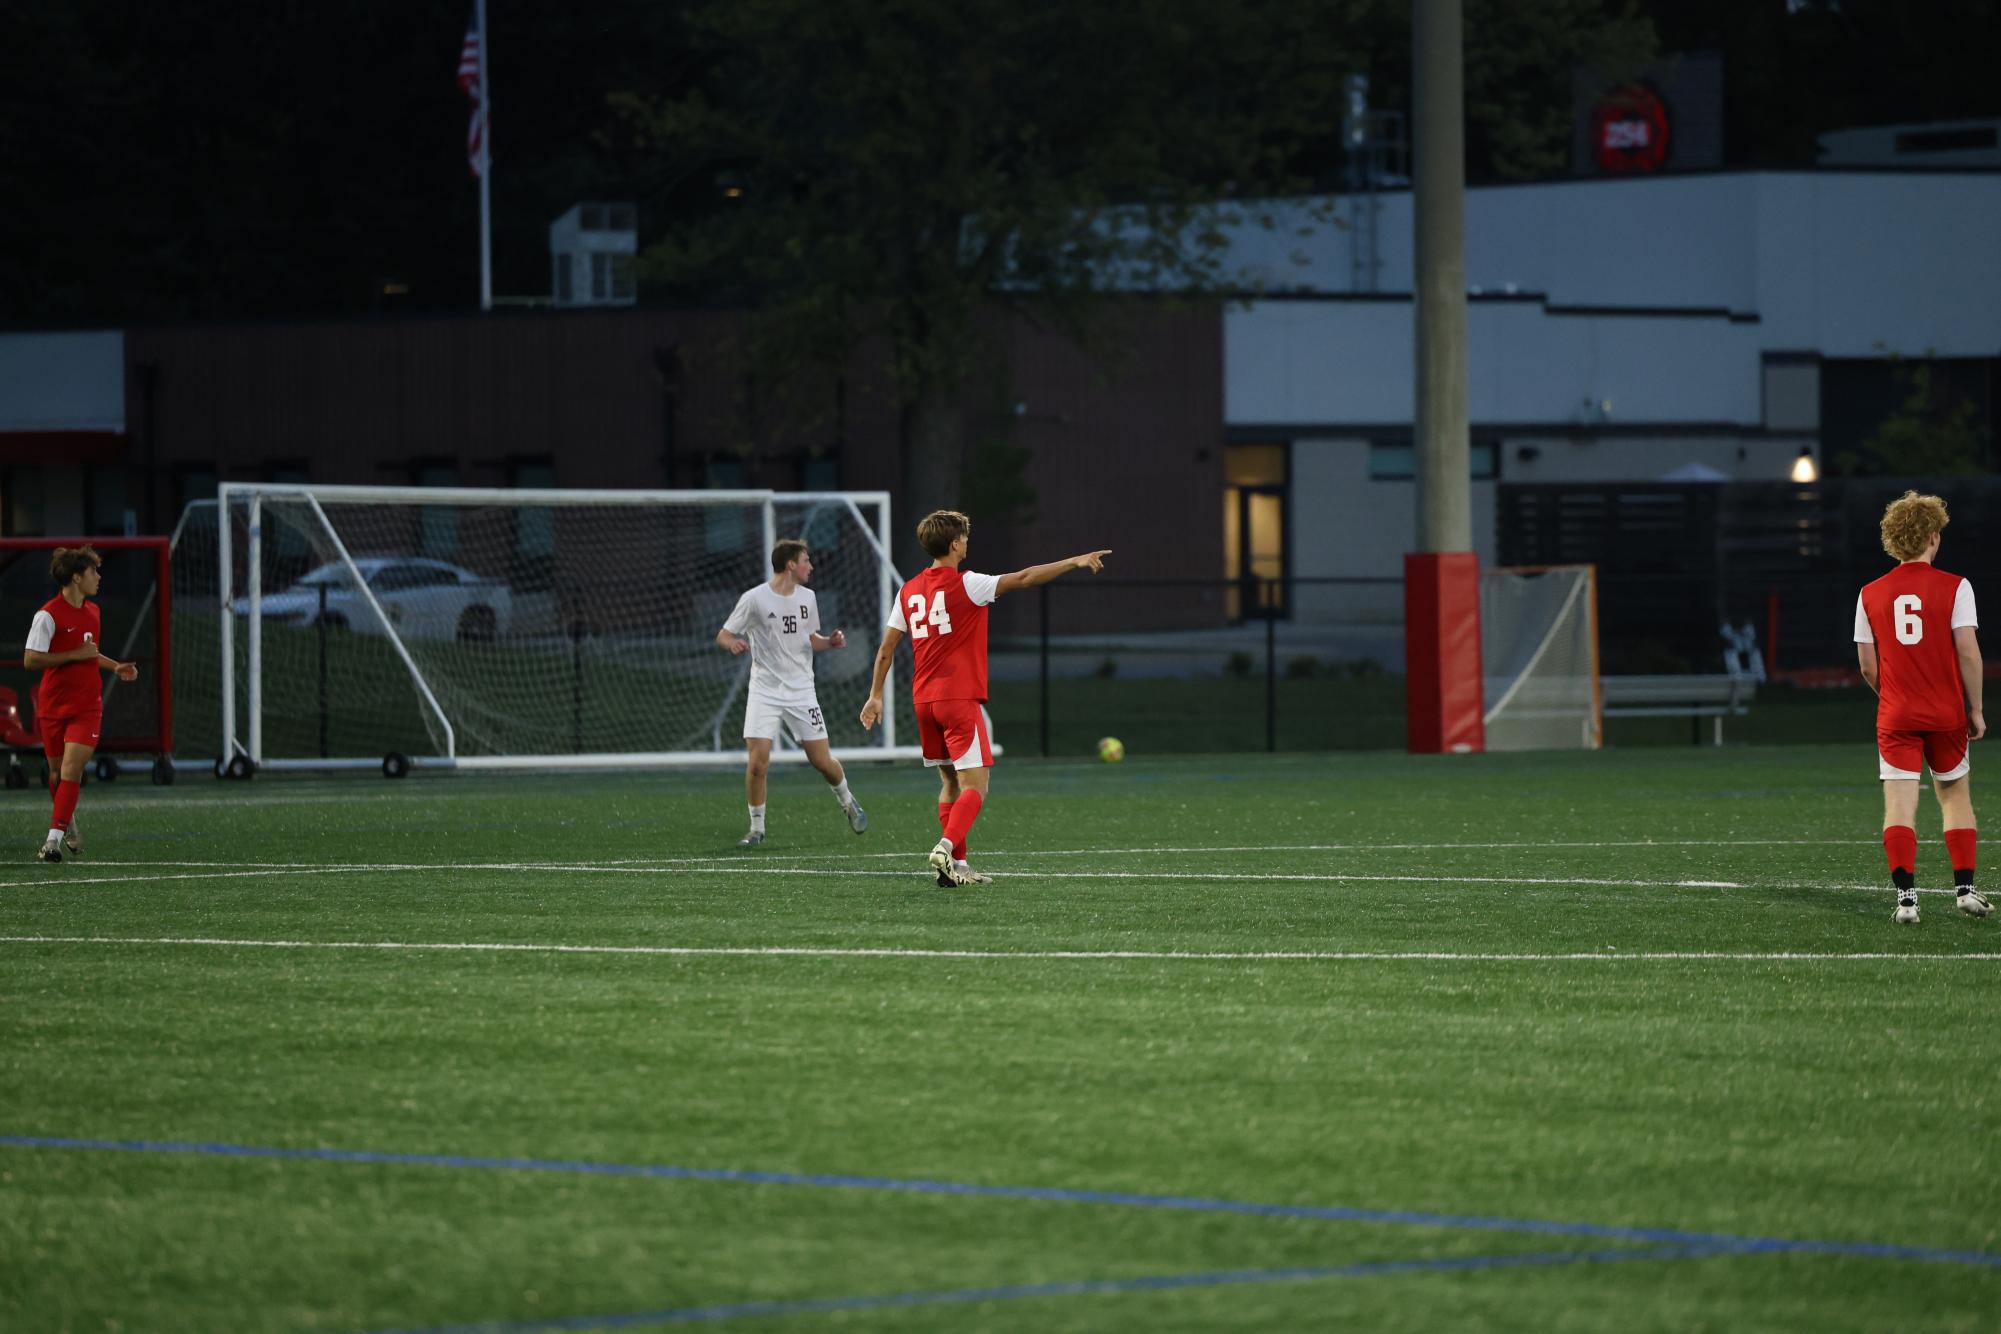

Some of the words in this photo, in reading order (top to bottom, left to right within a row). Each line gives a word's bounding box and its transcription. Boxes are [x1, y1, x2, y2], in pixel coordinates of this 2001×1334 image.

[783, 616, 797, 634] 36
[800, 605, 809, 619] B
[908, 591, 953, 639] 24
[1893, 595, 1923, 645] 6
